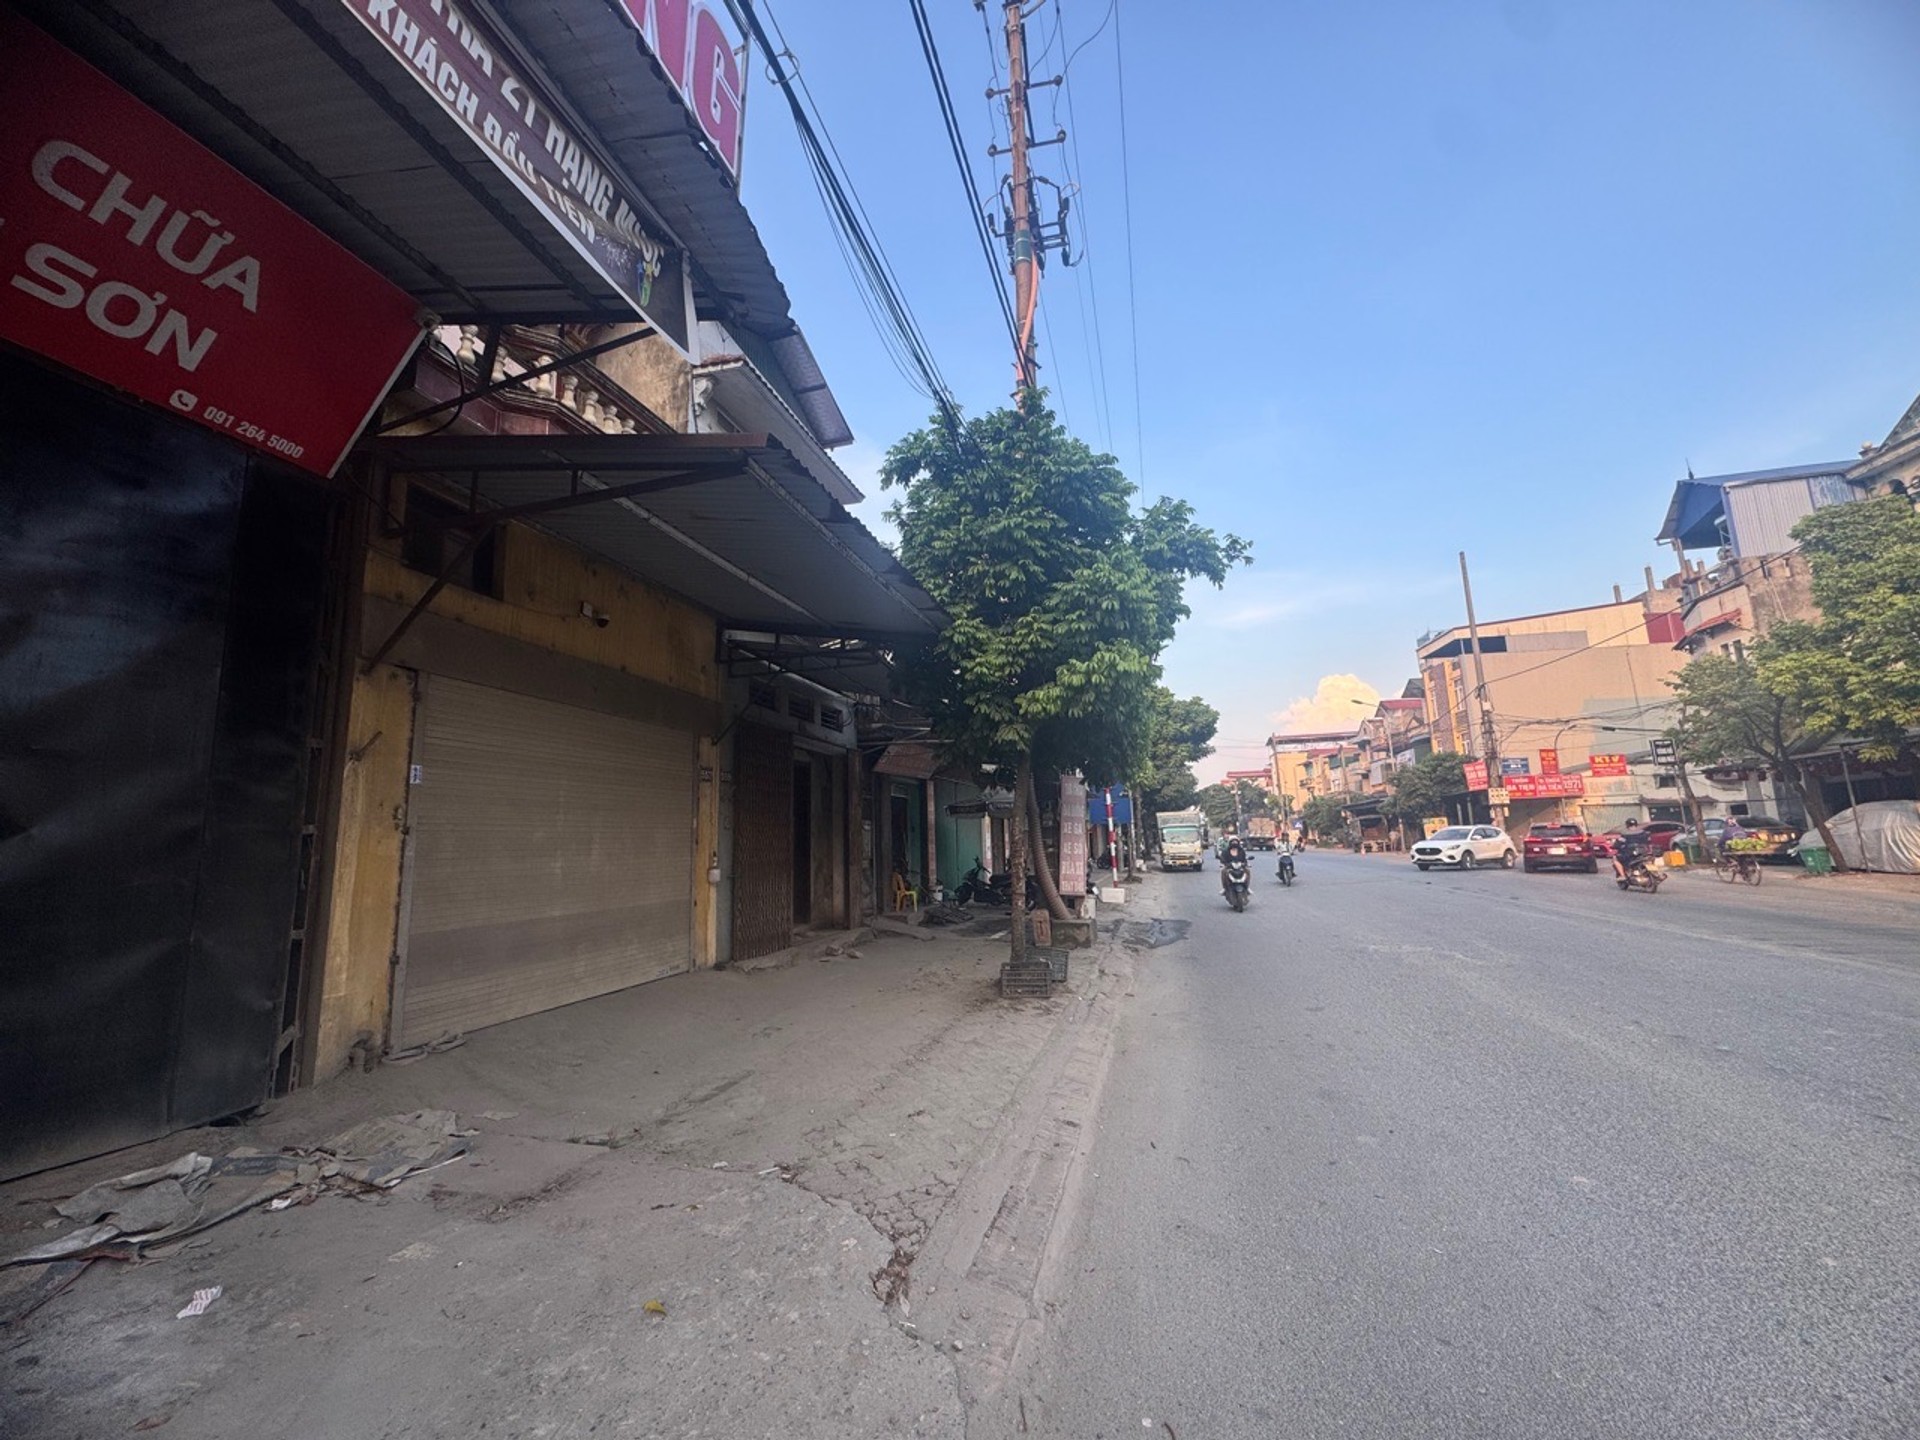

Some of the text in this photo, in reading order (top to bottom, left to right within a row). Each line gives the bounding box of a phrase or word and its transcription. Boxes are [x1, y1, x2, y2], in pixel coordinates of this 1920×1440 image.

[367, 0, 479, 125] KHÁCH
[30, 140, 262, 315] CHỮA
[10, 241, 218, 373] SƠN
[204, 405, 305, 460] 091 264 5000
